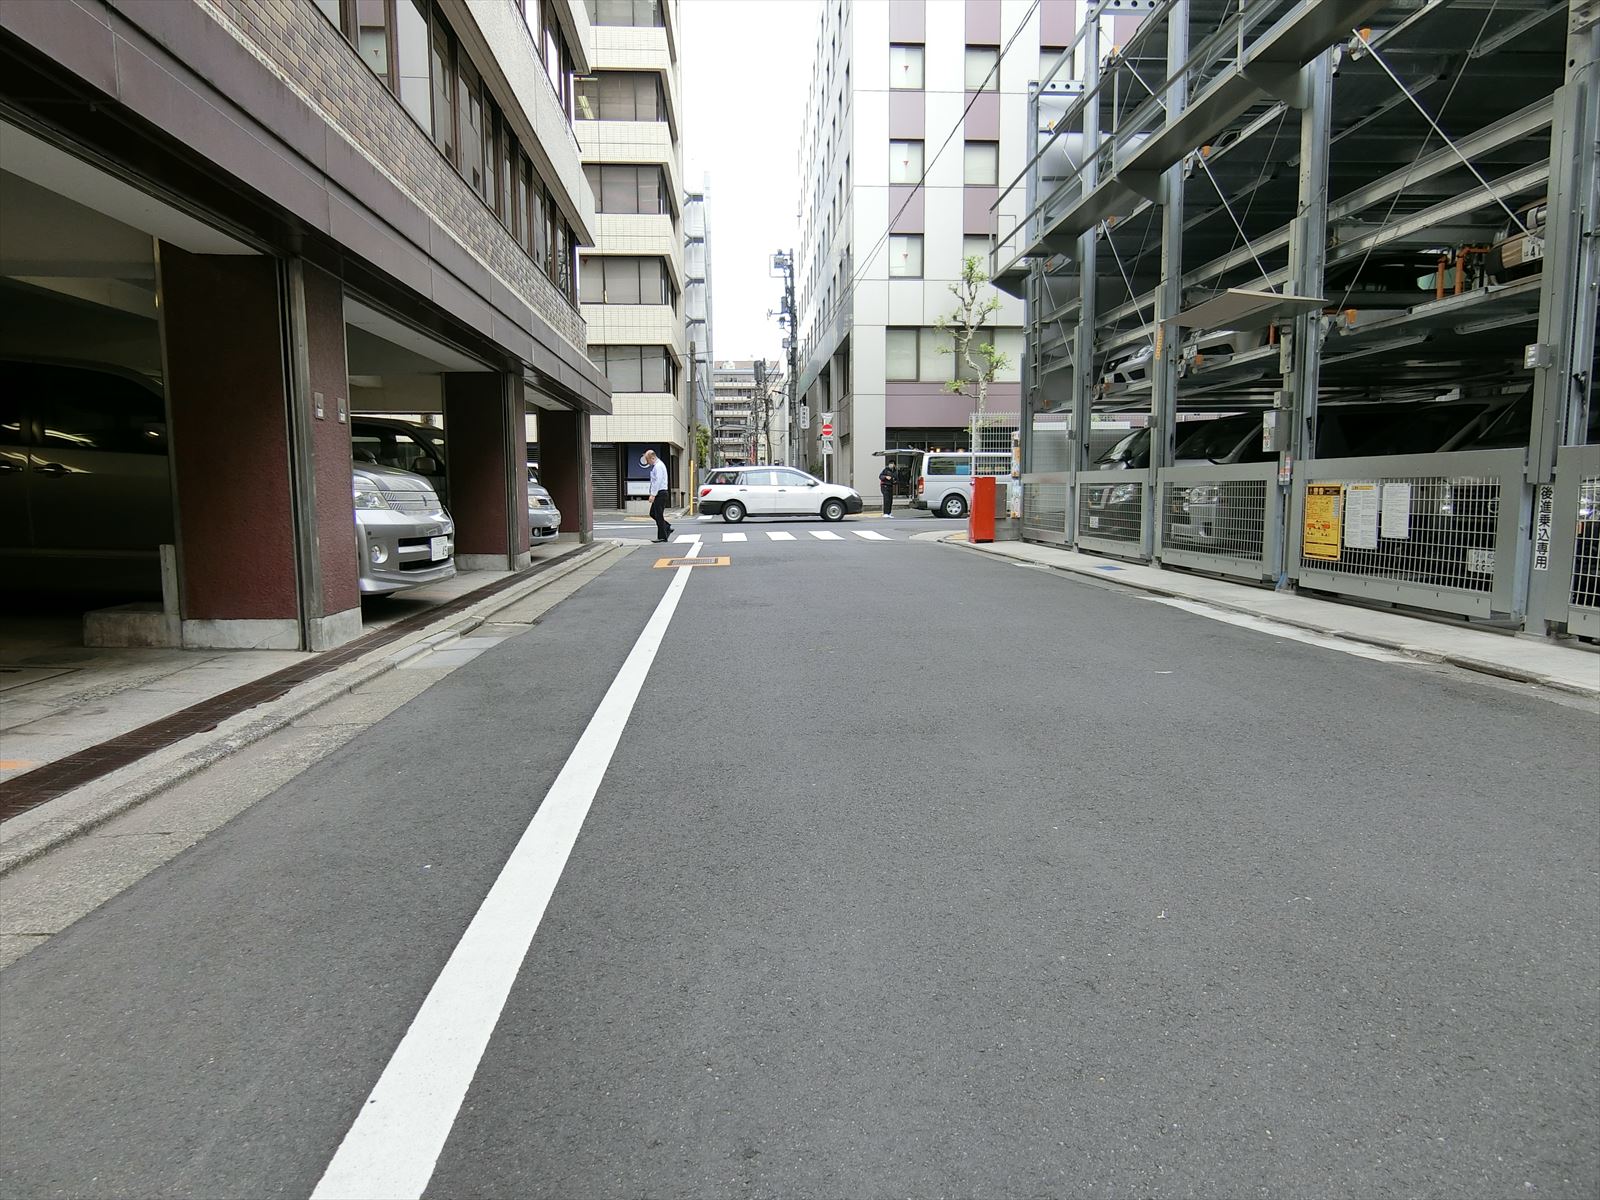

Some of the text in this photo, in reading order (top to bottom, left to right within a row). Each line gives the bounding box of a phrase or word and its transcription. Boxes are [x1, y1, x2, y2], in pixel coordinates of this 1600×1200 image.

[1534, 486, 1553, 569] 後進乗込専用
